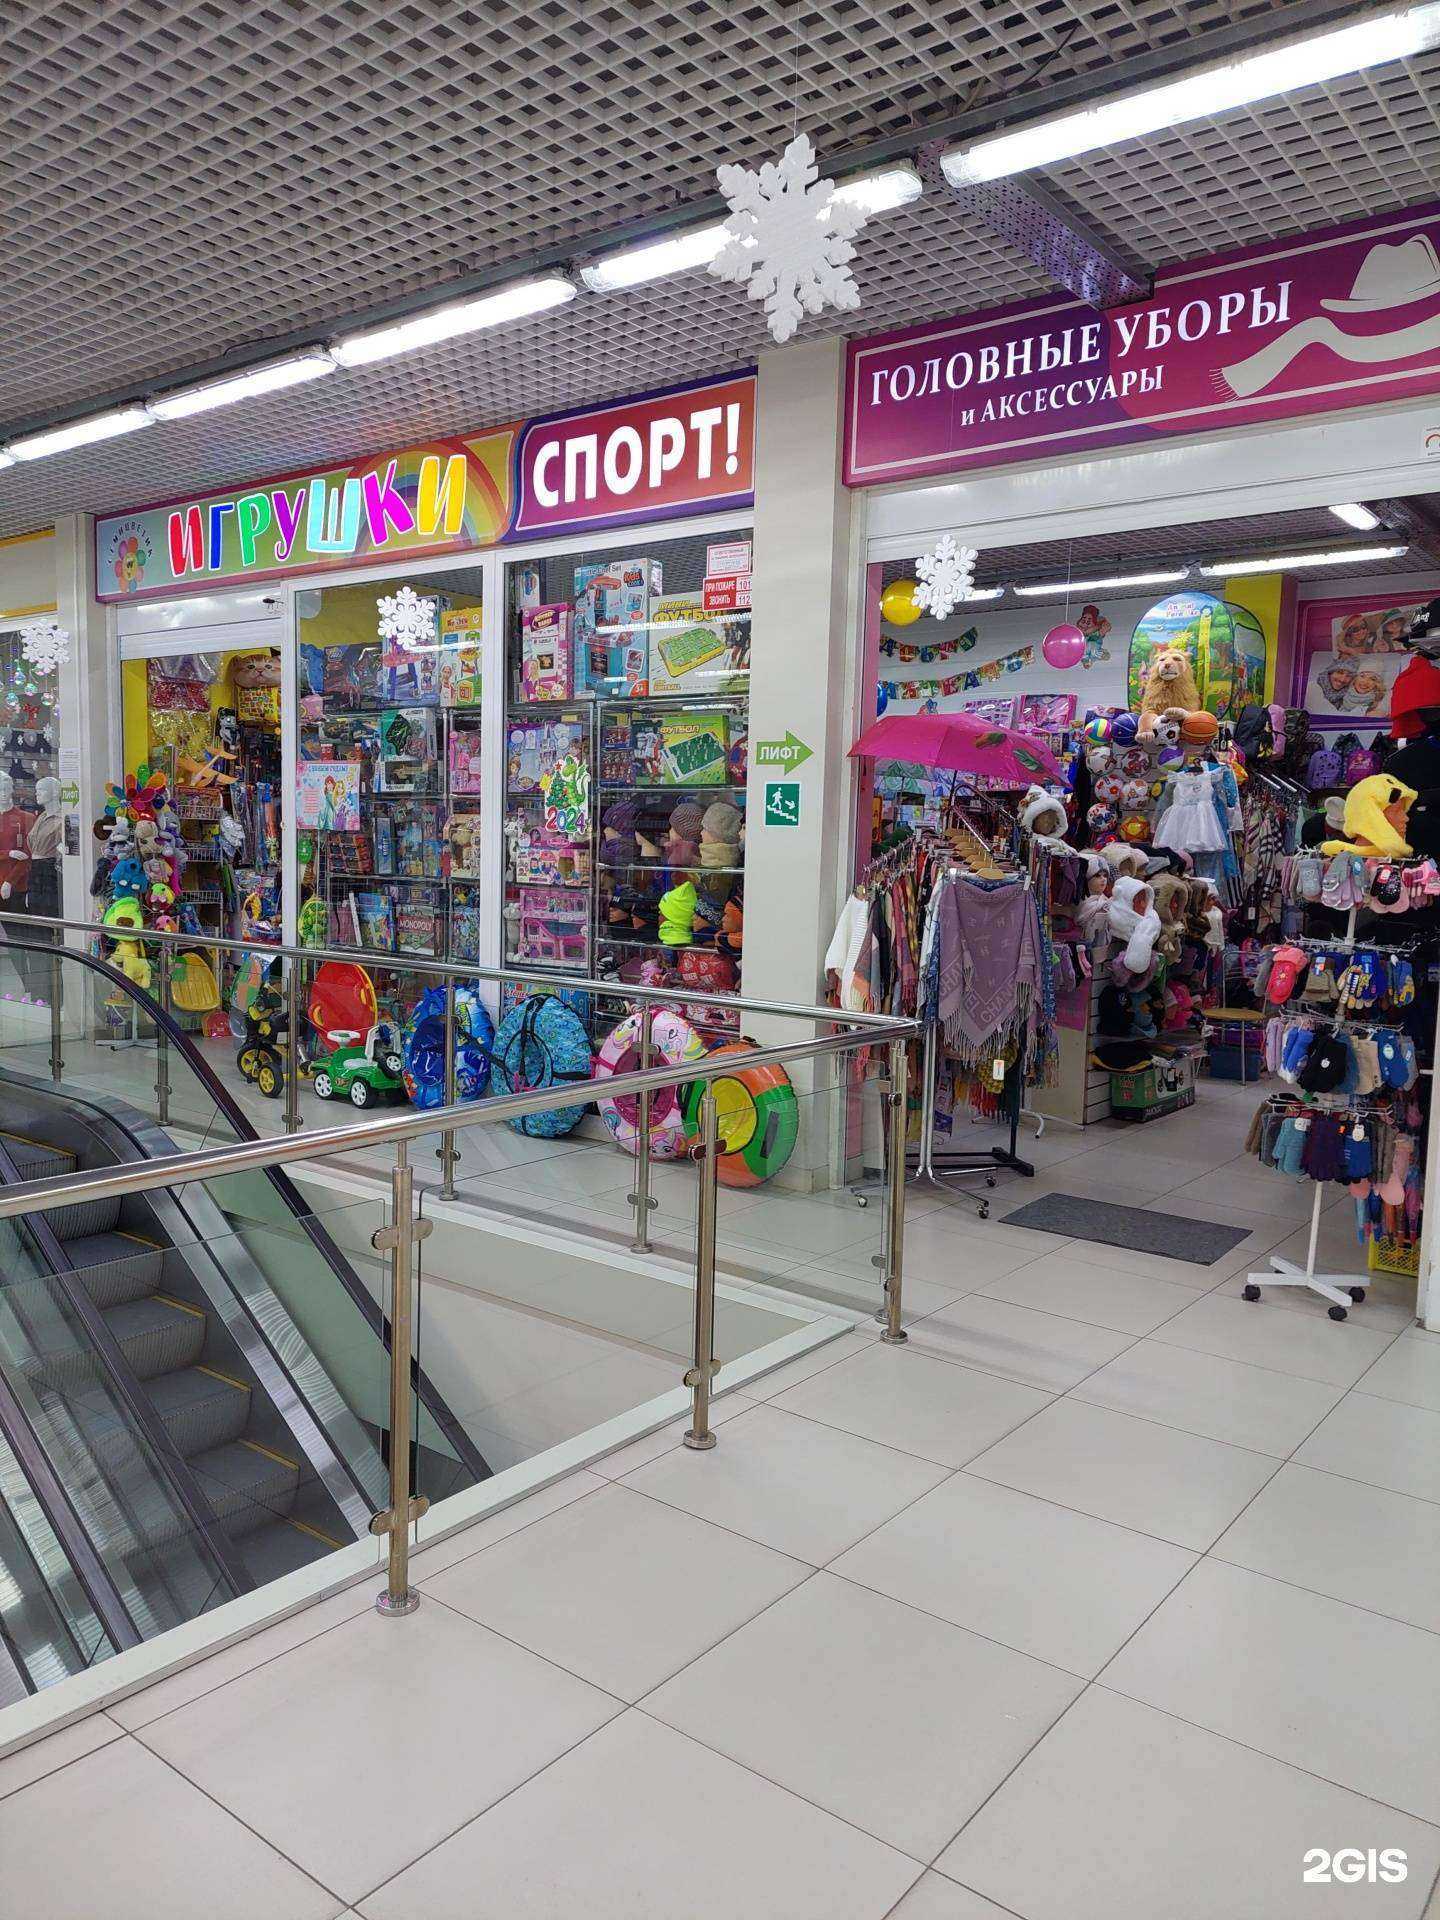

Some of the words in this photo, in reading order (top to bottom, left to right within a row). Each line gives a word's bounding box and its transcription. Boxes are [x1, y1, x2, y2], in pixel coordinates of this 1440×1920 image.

[870, 322, 1102, 406] ГОЛОВНЫЕ
[1114, 280, 1295, 357] УБОРЫ
[960, 408, 976, 427] и
[980, 364, 1165, 423] АКСЕССУАРЫ
[532, 402, 743, 508] СПОРТ!
[167, 453, 468, 577] ИГРУШКИ
[705, 582, 715, 592] ПРИ
[715, 580, 736, 592] ПОЖАРЕ
[709, 594, 731, 606] ЗВОНИТЬ
[759, 745, 801, 760] ЛИФТ
[546, 806, 586, 833] 2024
[399, 918, 432, 931] MONOPOLY
